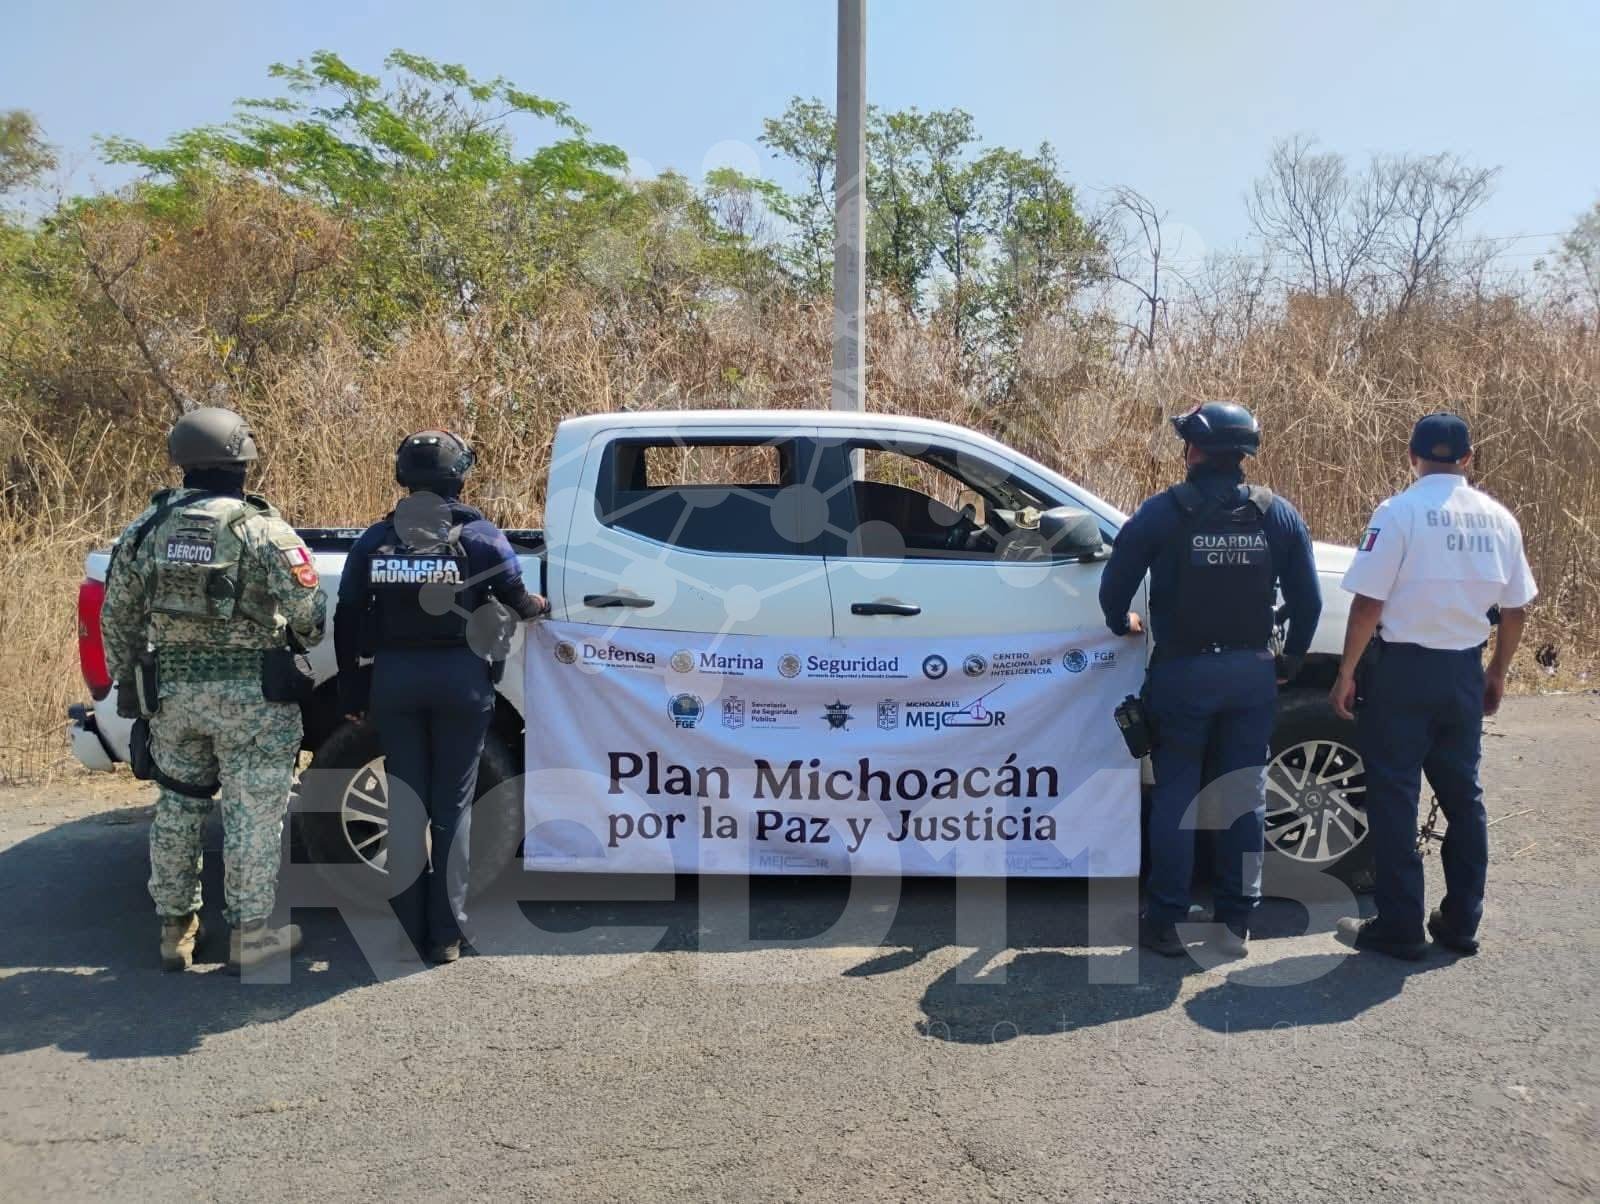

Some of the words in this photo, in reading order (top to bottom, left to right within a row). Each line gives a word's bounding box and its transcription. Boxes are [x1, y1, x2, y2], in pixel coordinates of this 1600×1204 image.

[1192, 535, 1265, 548] GUARDIA
[1446, 533, 1494, 552] CIVIL
[167, 542, 212, 561] EJÉRCITO
[1207, 551, 1250, 564] CIVIL
[371, 570, 464, 584] MUNICIPAL
[583, 644, 656, 664] Defensa
[700, 652, 764, 669] Marina
[993, 652, 1029, 660] CENTRO
[1094, 652, 1114, 660] FGR
[807, 655, 899, 674] Seguridad
[993, 659, 1038, 669] NACIONAL
[991, 667, 1052, 676] INTELIGENCIA
[762, 708, 798, 717] Seguridad
[675, 720, 696, 729] FGE
[607, 751, 731, 799] Plan
[753, 752, 1059, 801] Michoacán
[607, 809, 685, 848] por
[702, 806, 738, 840] la
[755, 809, 831, 844] Paz
[848, 817, 873, 853] y
[887, 806, 1057, 843] Justicia
